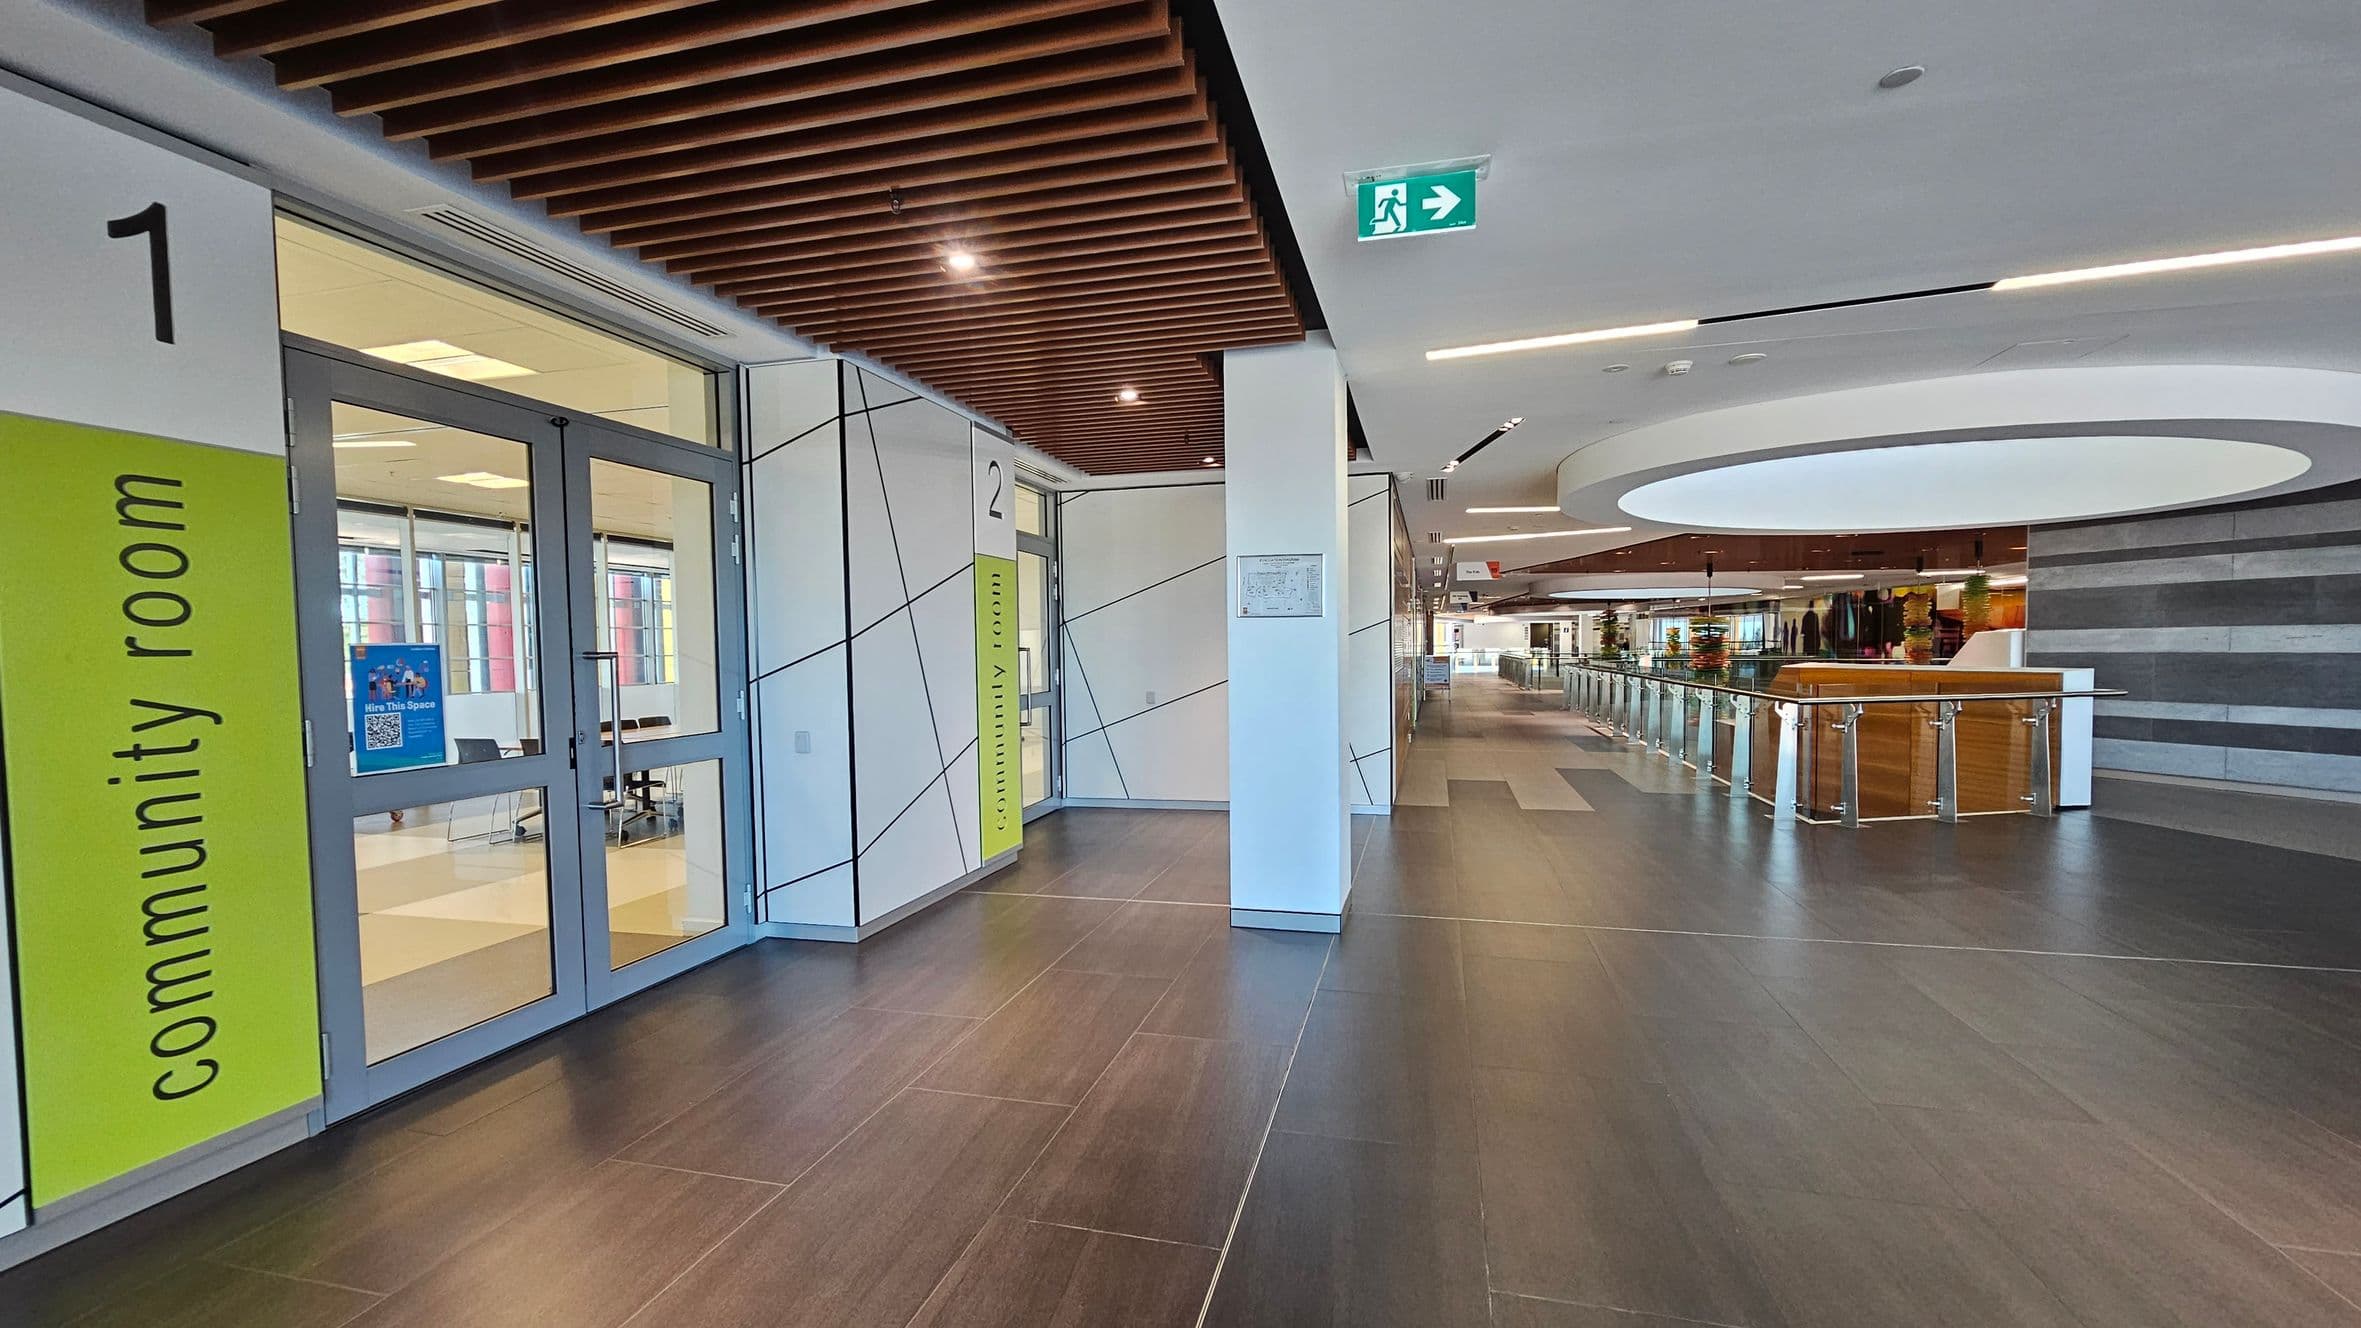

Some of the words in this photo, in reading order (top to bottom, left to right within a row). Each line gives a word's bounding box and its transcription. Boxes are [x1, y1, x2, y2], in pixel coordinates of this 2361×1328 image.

[106, 201, 175, 345] 1
[988, 459, 1003, 520] 2
[113, 473, 194, 659] room
[990, 571, 1003, 650] room
[364, 703, 385, 713] Hire
[386, 701, 406, 711] This
[407, 700, 436, 711] Space
[991, 662, 1008, 832] community
[107, 697, 223, 1102] community
